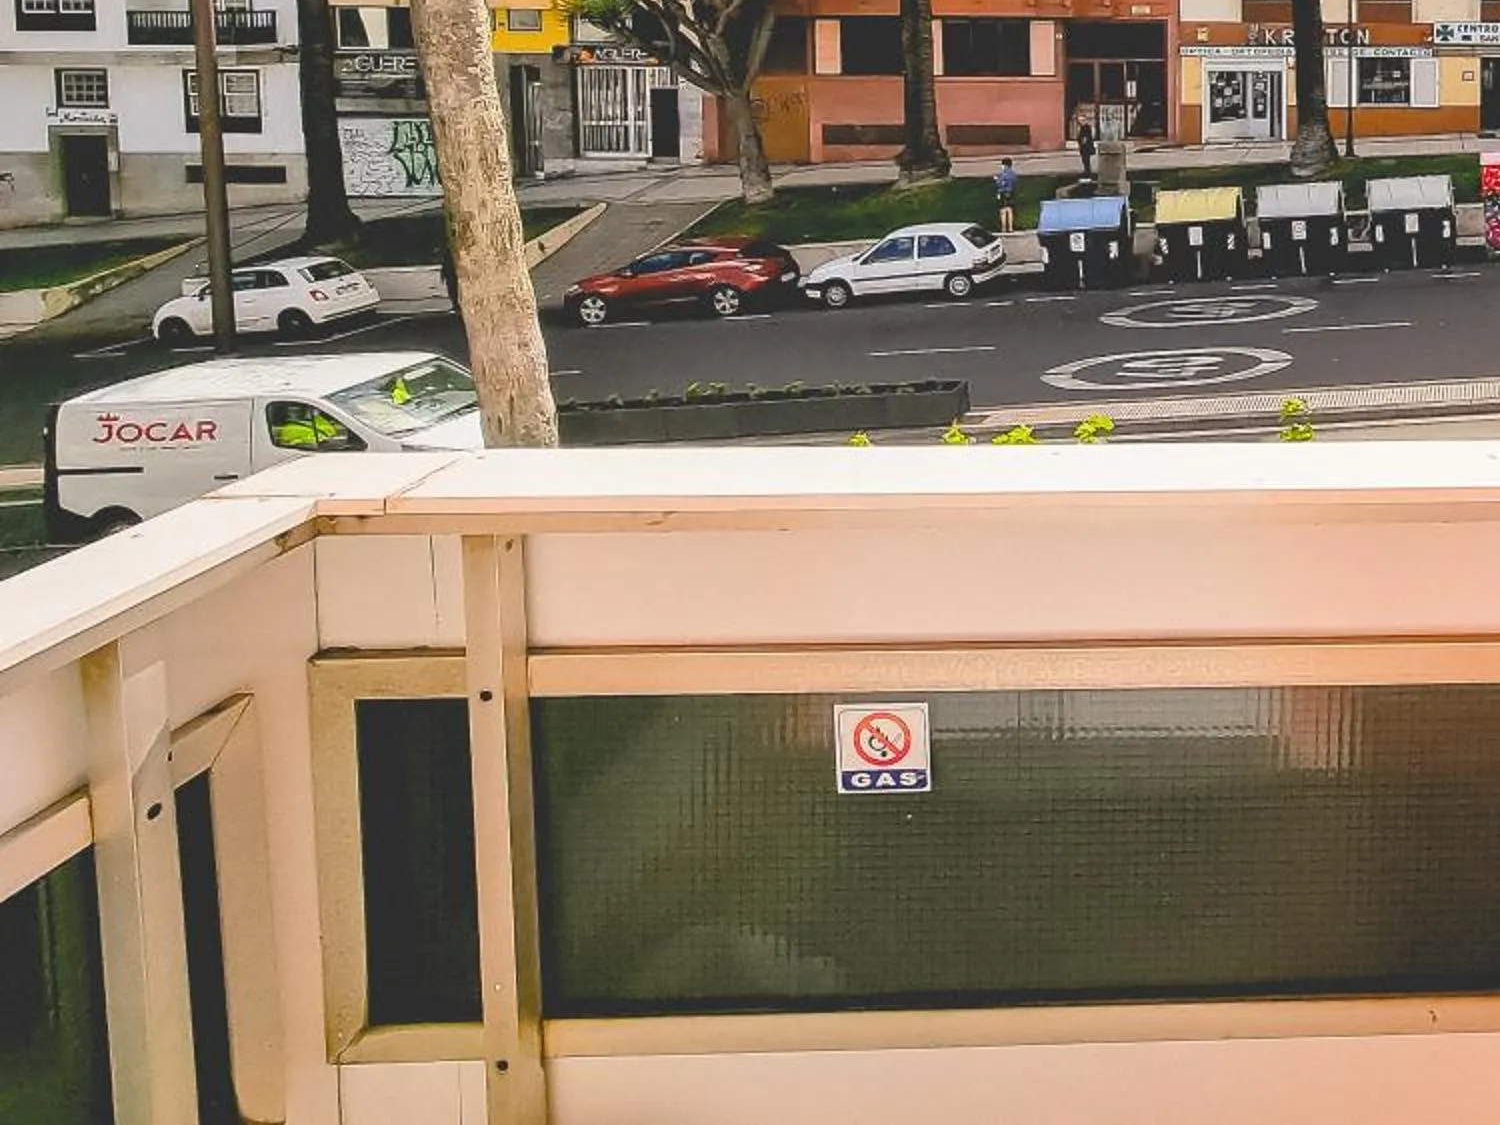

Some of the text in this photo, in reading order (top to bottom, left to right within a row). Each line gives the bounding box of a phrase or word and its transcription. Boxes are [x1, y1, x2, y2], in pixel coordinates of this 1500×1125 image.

[1264, 28, 1370, 45] KRTON
[1457, 25, 1499, 34] CENTRO
[92, 420, 218, 443] JOCAR
[851, 772, 918, 787] GAS
